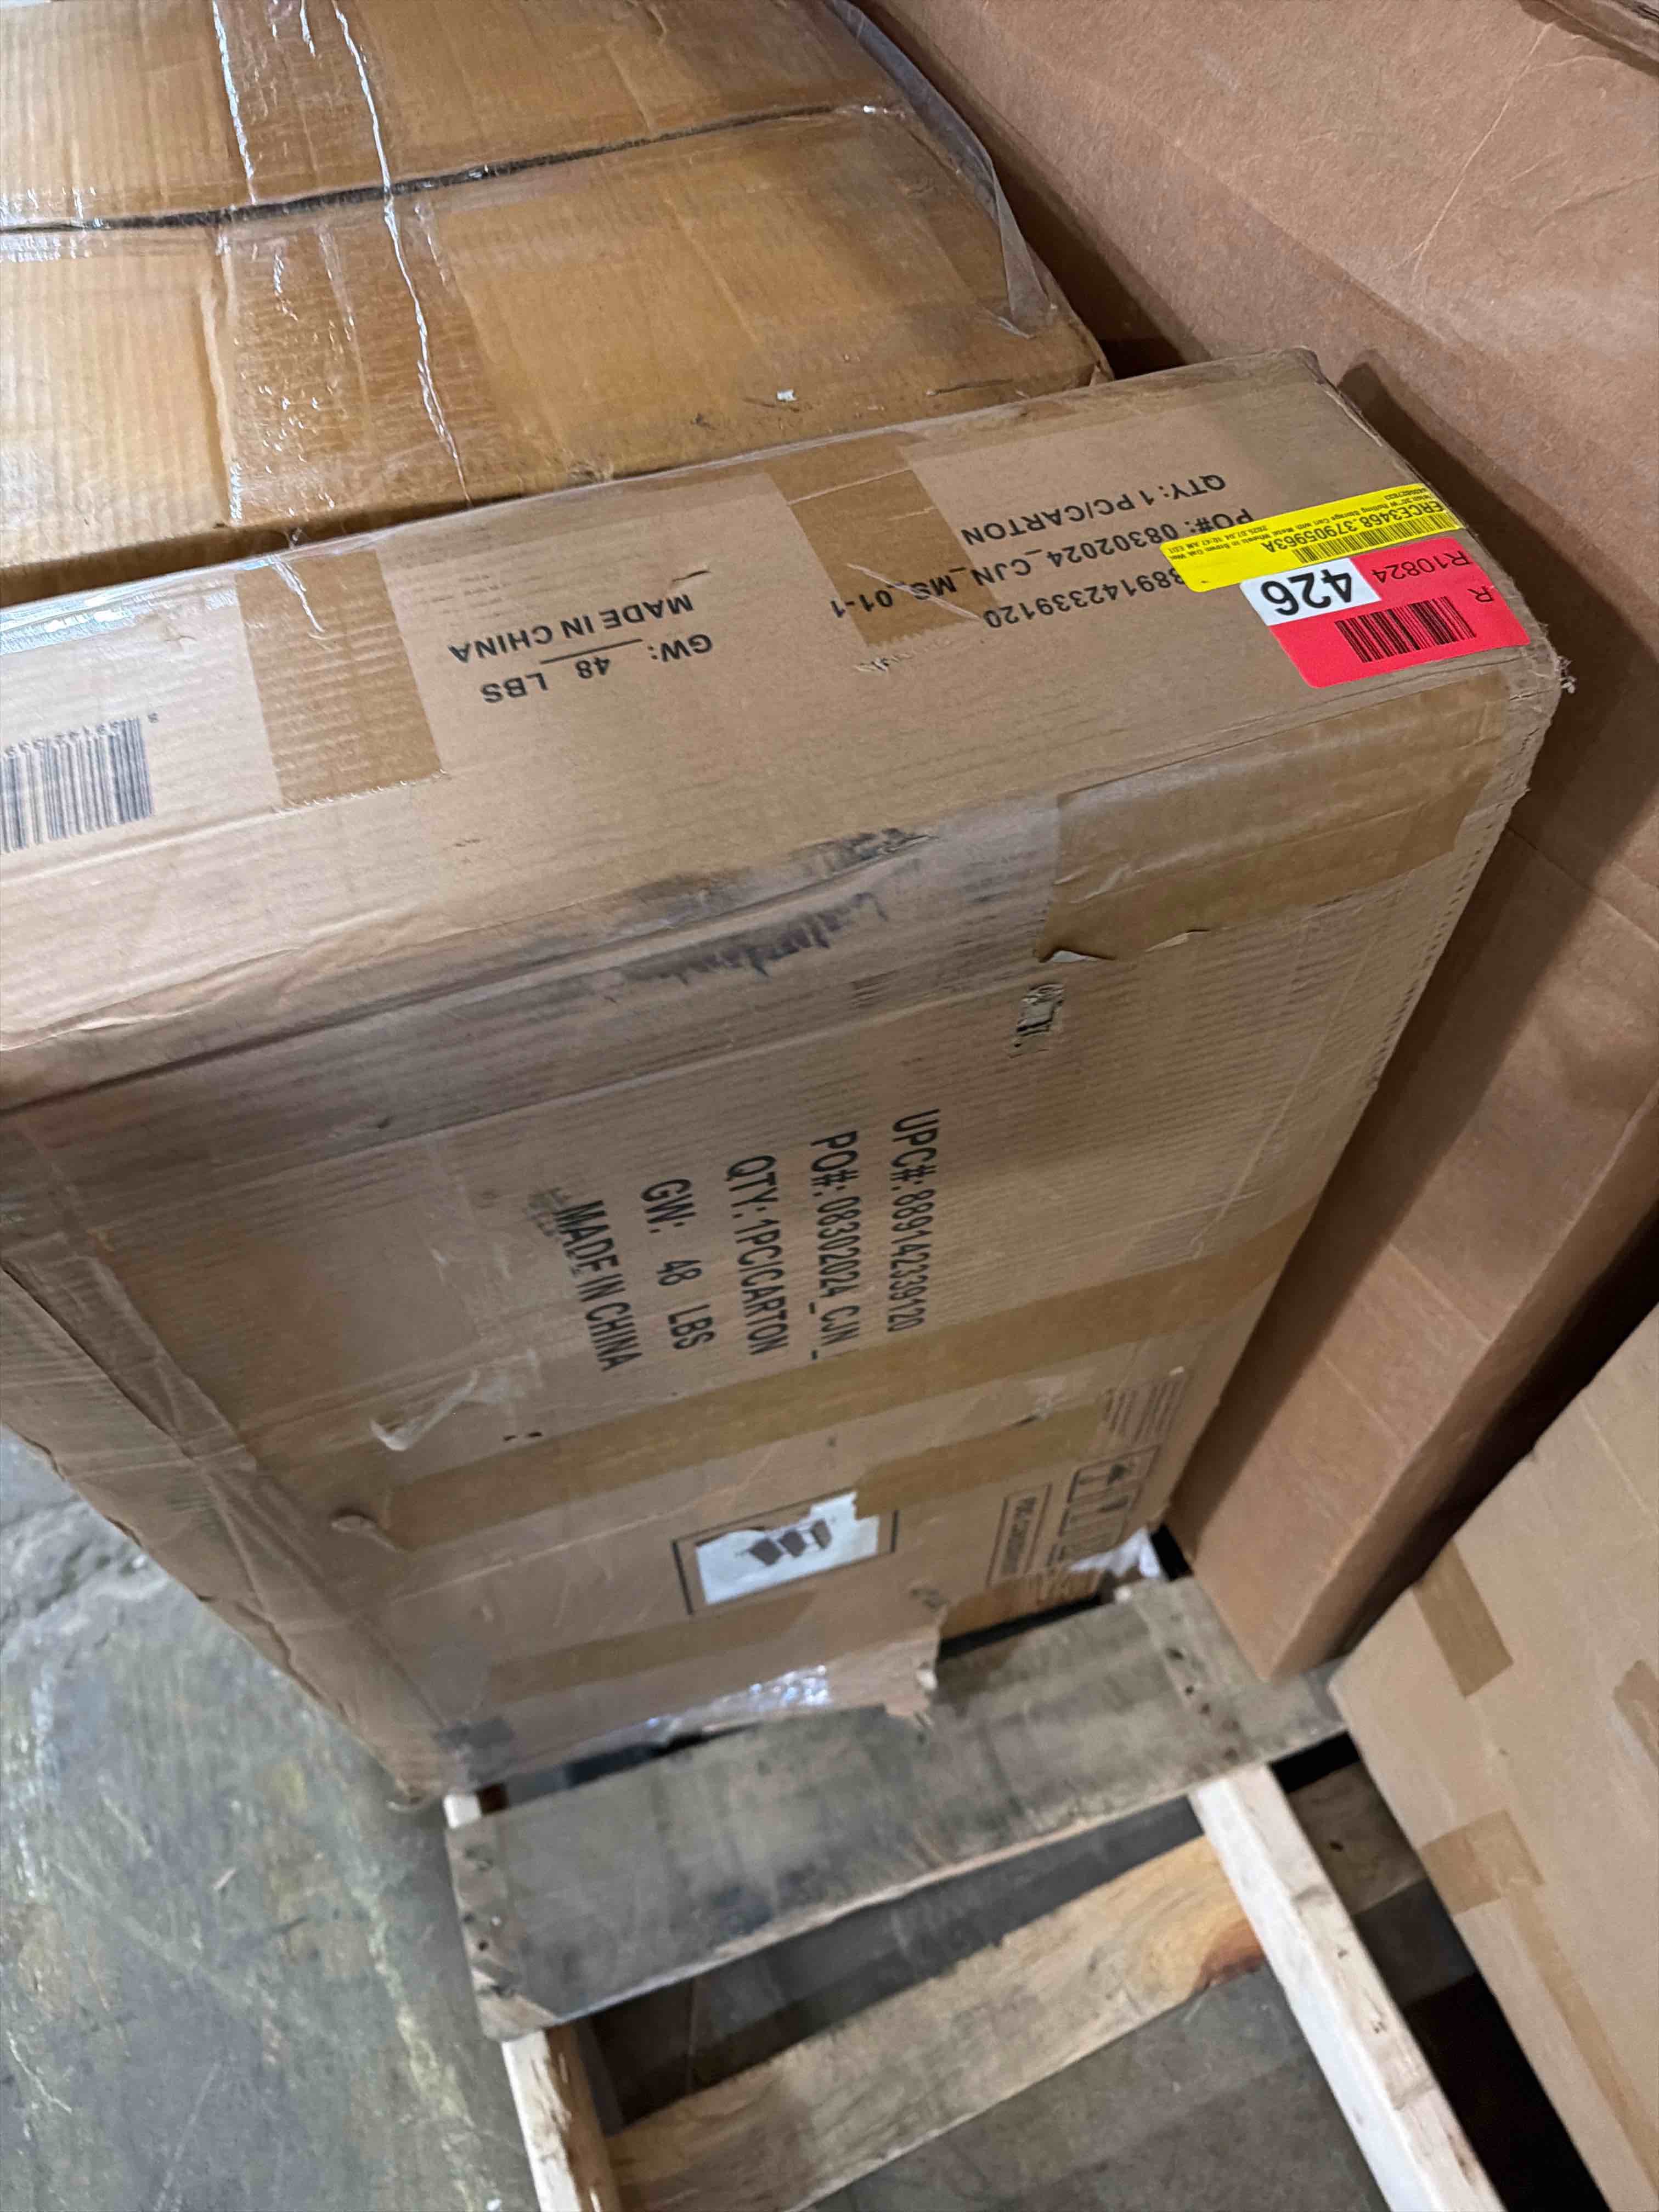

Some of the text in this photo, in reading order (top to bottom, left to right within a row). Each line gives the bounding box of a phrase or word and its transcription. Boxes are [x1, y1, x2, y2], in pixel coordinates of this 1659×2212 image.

[1159, 475, 1226, 500] QTY:
[1184, 509, 1254, 534] PO#:
[1261, 501, 1444, 553] ERCE3468.37905963A
[1372, 550, 1470, 584] R10824
[1261, 568, 1352, 617] 426
[1467, 585, 1495, 603] R
[447, 594, 695, 664] MADE IN CHINA
[480, 633, 713, 703] GW: 48 LBS
[551, 1199, 644, 1373] MADE IN CHINA
[640, 1178, 716, 1350] GW: 48 LBS
